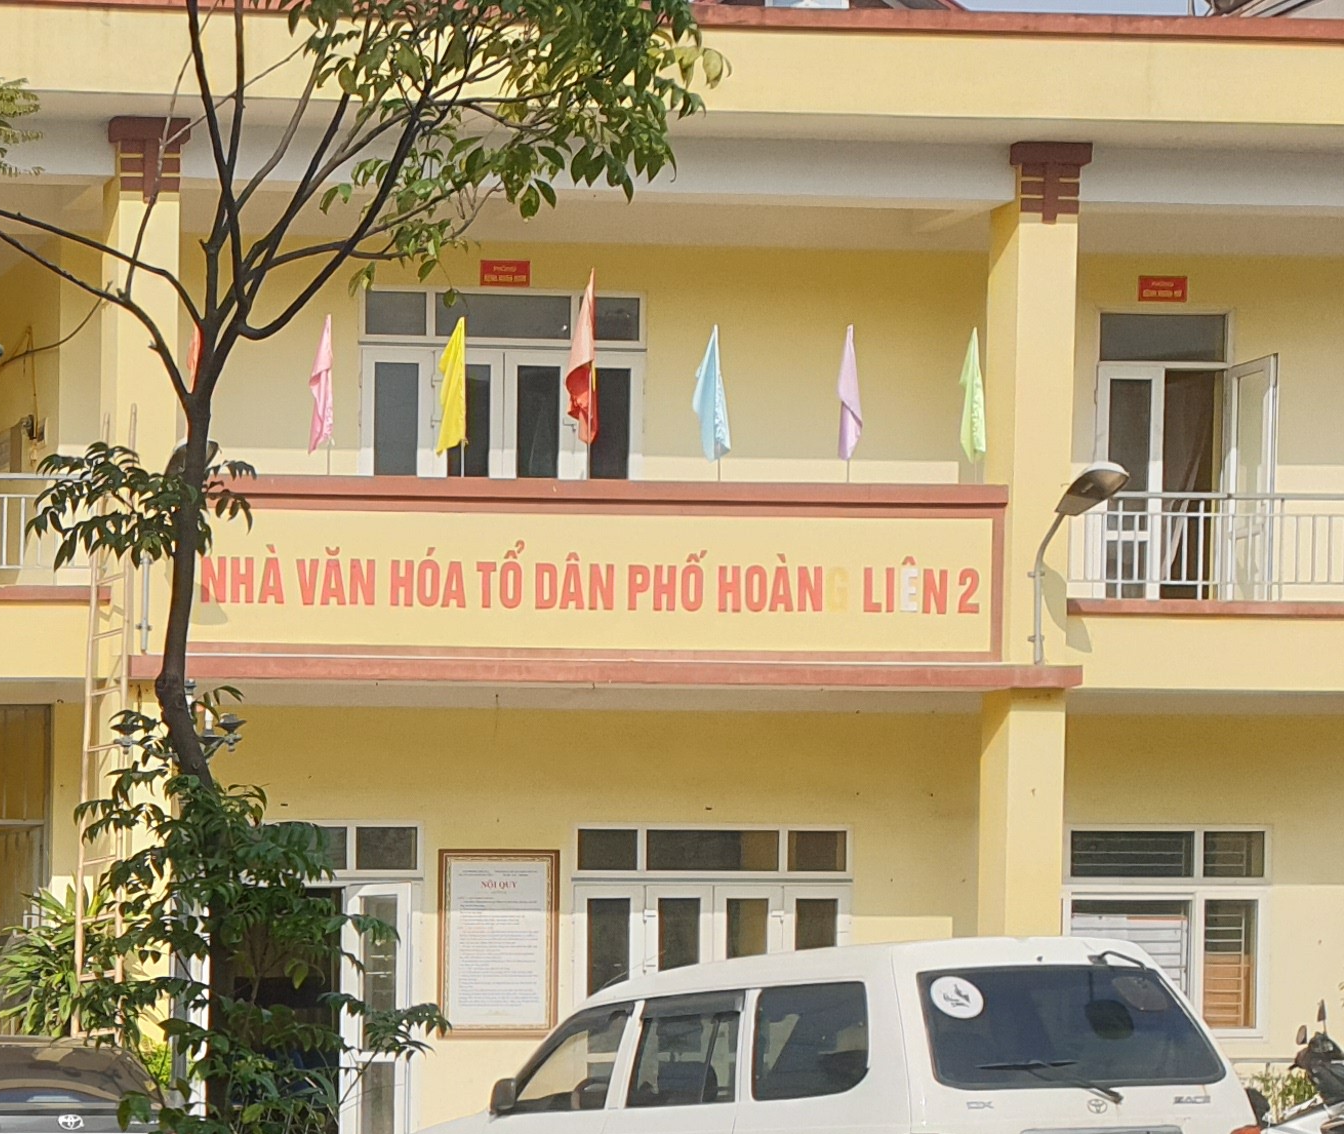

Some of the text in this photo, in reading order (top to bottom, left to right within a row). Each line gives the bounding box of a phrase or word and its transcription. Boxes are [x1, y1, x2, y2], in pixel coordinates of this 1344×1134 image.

[200, 544, 284, 604] NHÀ
[296, 546, 376, 606] VĂN
[389, 547, 467, 609] HÓA
[476, 540, 526, 609] TỔ
[534, 552, 615, 611] DÂN
[627, 549, 708, 612] PHỐ
[863, 556, 948, 615] LIÊN
[956, 568, 981, 614] 2
[499, 880, 518, 890] QUY
